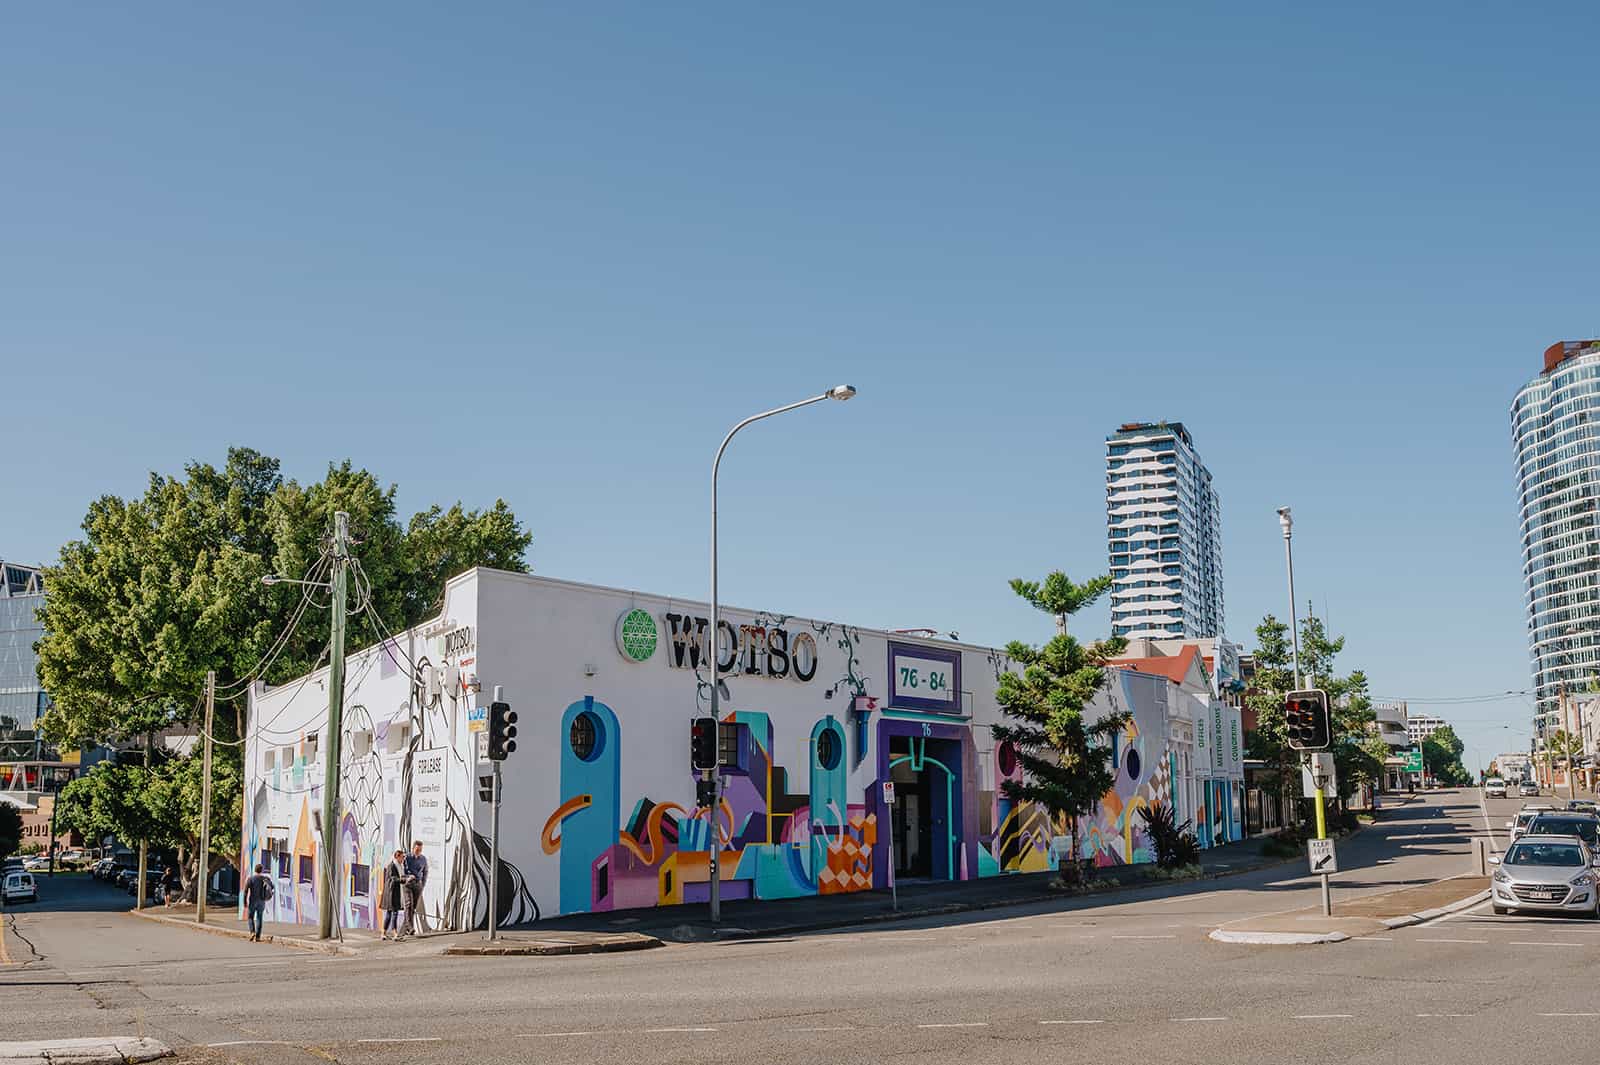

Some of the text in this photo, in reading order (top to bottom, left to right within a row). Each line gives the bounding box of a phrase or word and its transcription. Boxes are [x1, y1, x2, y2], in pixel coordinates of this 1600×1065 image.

[666, 613, 817, 681] WOTSO
[900, 668, 918, 688] 76
[930, 672, 945, 690] 84
[922, 723, 931, 736] 76
[418, 756, 441, 774] FOR LEASE
